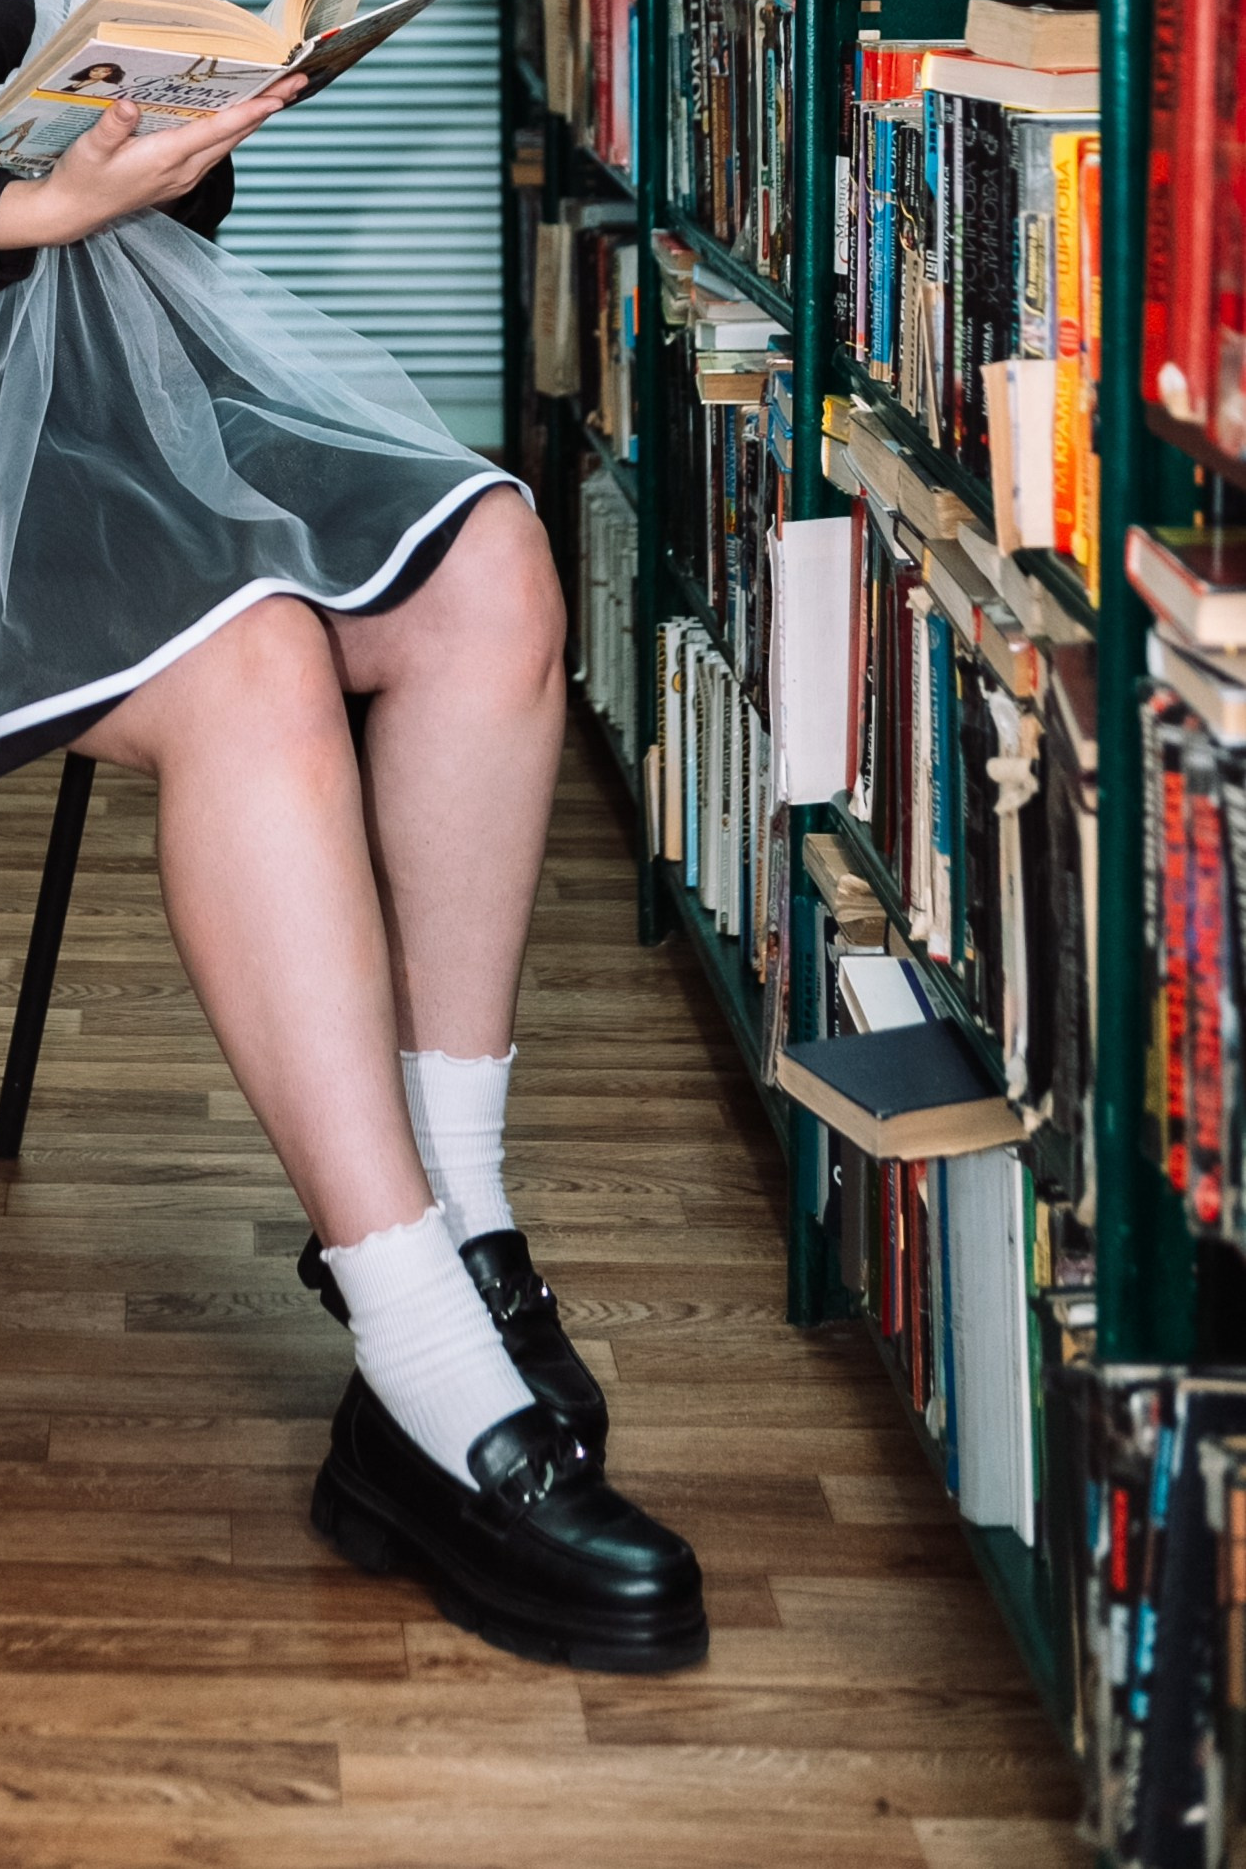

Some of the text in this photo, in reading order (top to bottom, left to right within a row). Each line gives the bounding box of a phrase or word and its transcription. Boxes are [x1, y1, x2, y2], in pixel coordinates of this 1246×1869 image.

[835, 178, 847, 239] МАРИНА
[963, 161, 978, 294] УСТИНОВА
[981, 167, 999, 304] УСТИНОВА
[1056, 159, 1071, 276] ШИЛОВА
[1053, 370, 1070, 464] КРАМЕР
